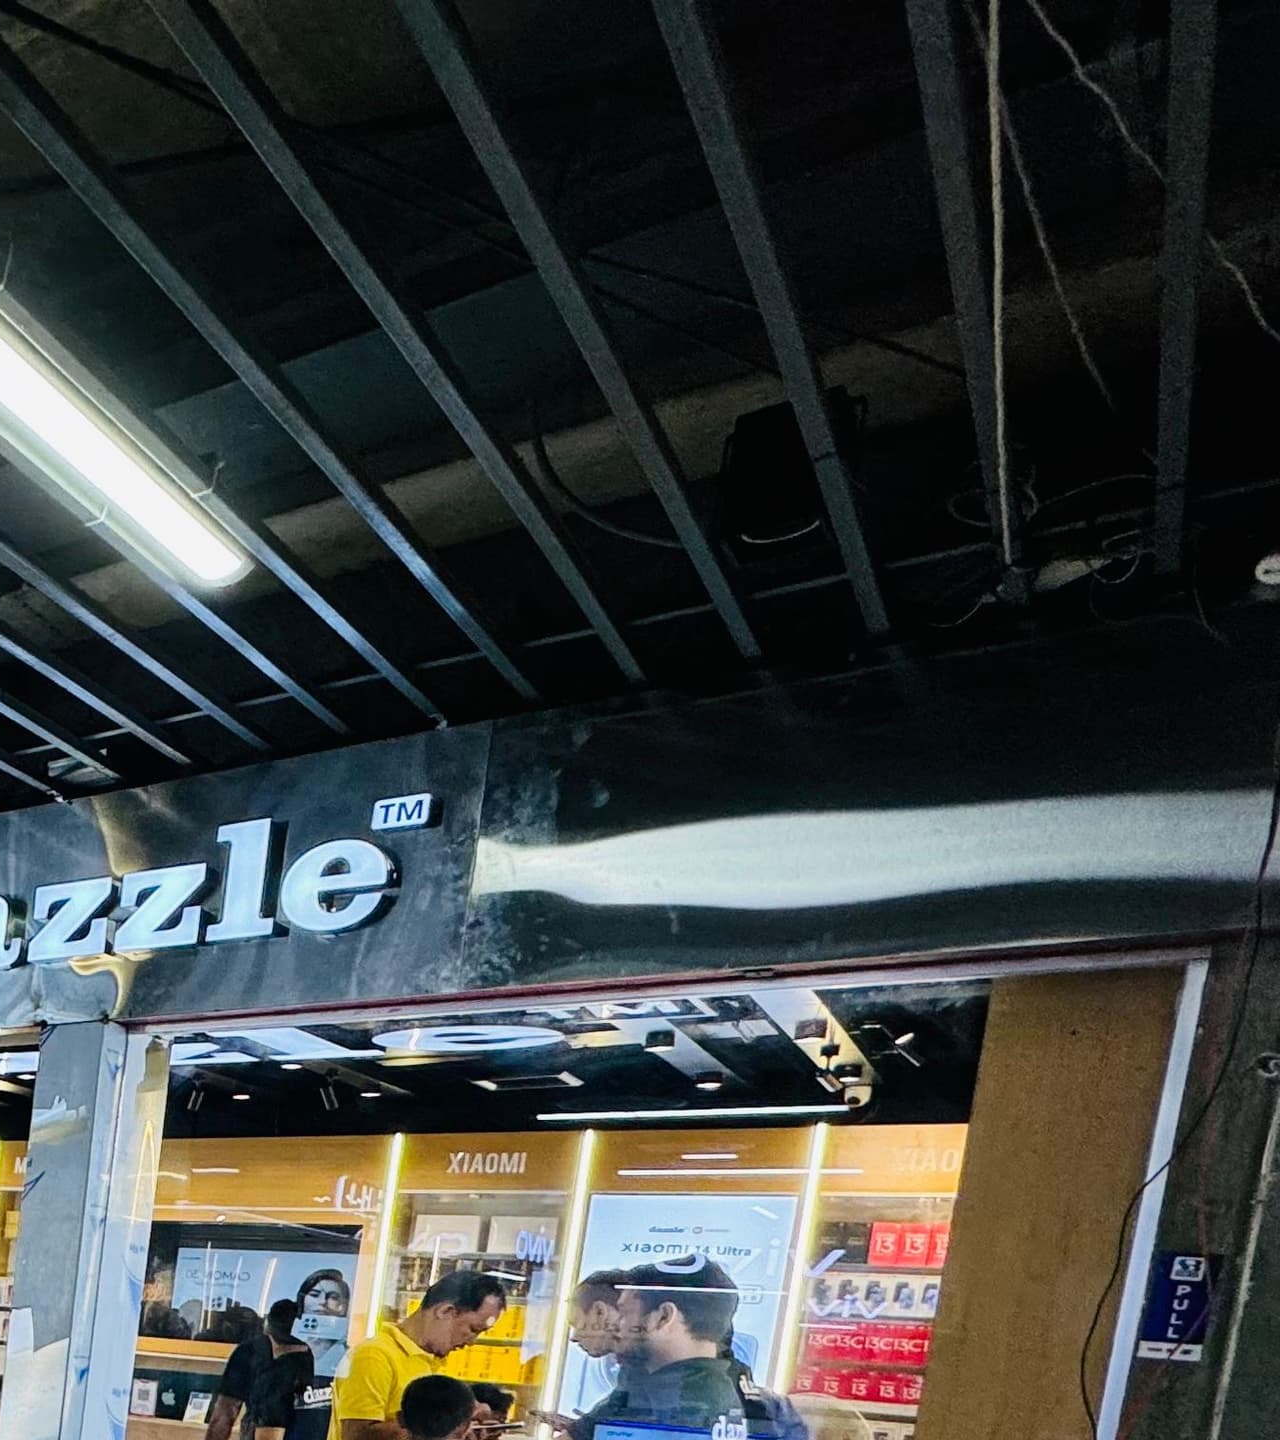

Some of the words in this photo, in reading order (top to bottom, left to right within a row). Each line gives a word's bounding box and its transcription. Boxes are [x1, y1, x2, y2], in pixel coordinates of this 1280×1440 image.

[446, 1151, 528, 1175] XIAOMI
[716, 1244, 753, 1257] Ultra
[875, 1236, 896, 1254] 13
[904, 1236, 925, 1255] 13
[1166, 1284, 1193, 1339] PULL
